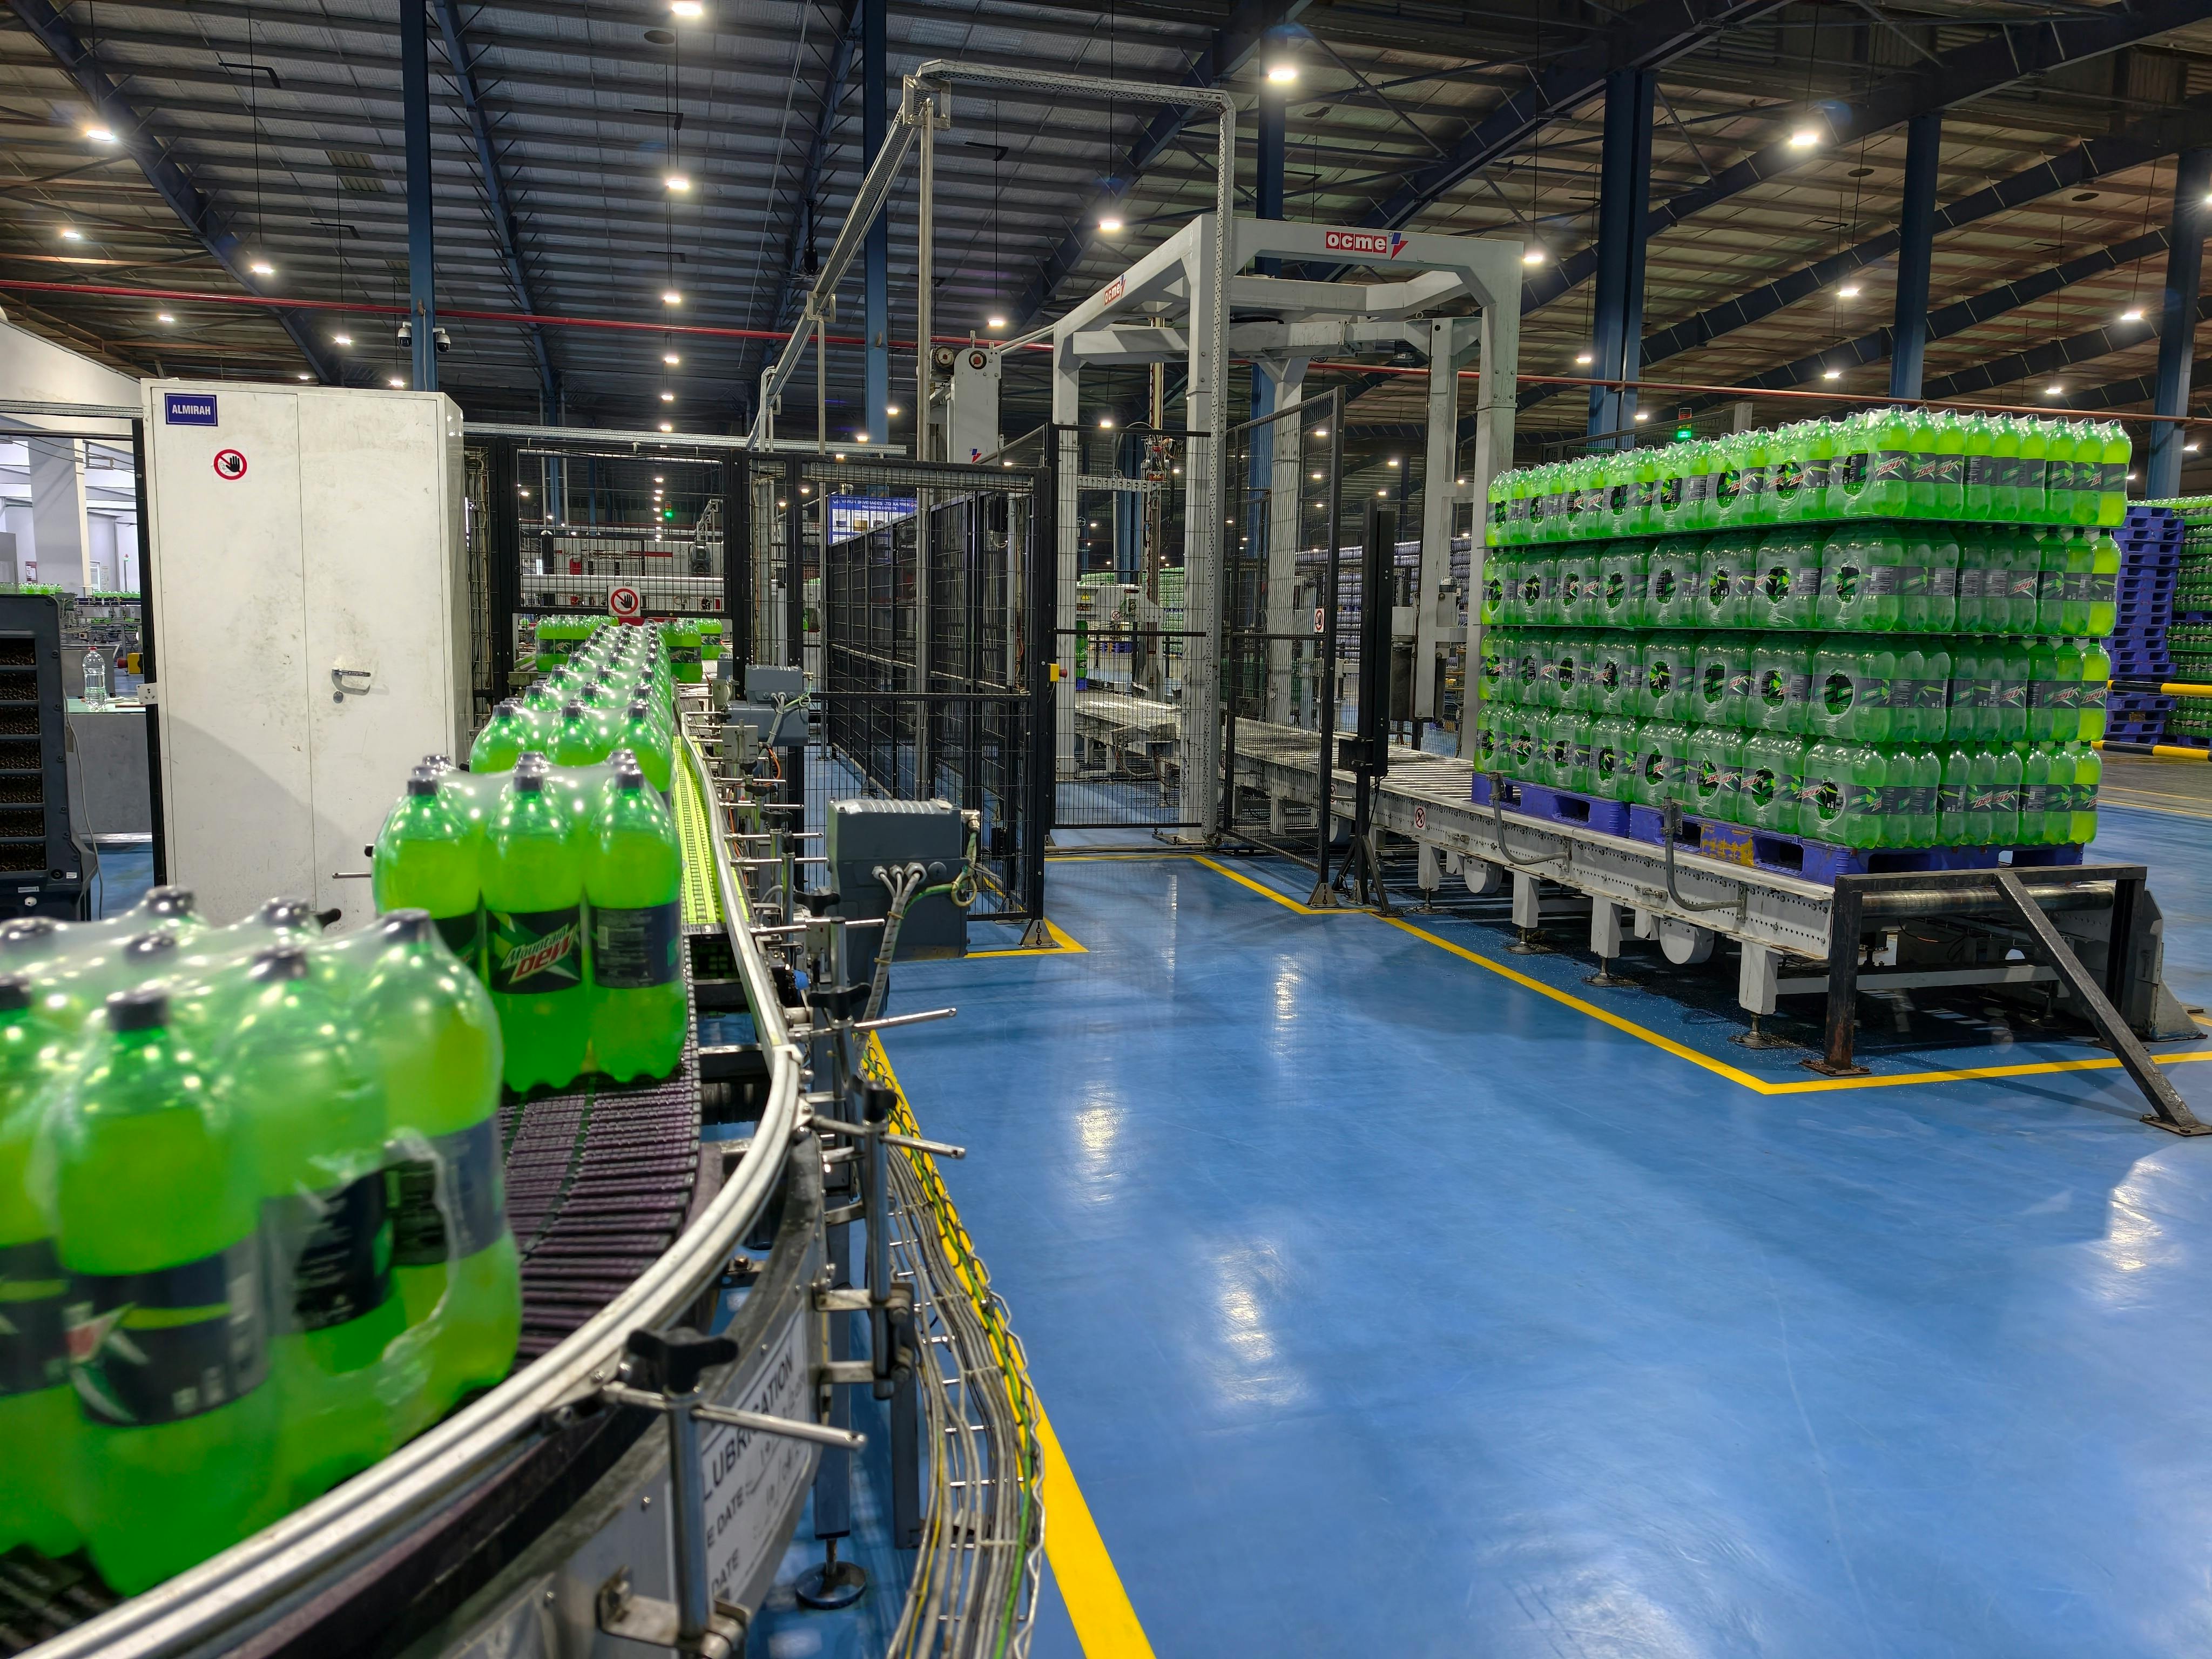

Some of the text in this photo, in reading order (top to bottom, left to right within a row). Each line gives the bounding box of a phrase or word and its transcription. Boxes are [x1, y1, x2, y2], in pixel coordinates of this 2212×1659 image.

[1327, 233, 1386, 251] ocme
[1105, 282, 1121, 304] ocme
[172, 404, 211, 415] ALMIRAH
[1771, 477, 1784, 487] De
[1793, 474, 1805, 485] De
[1707, 774, 1719, 783] De
[508, 926, 568, 966] Mountain
